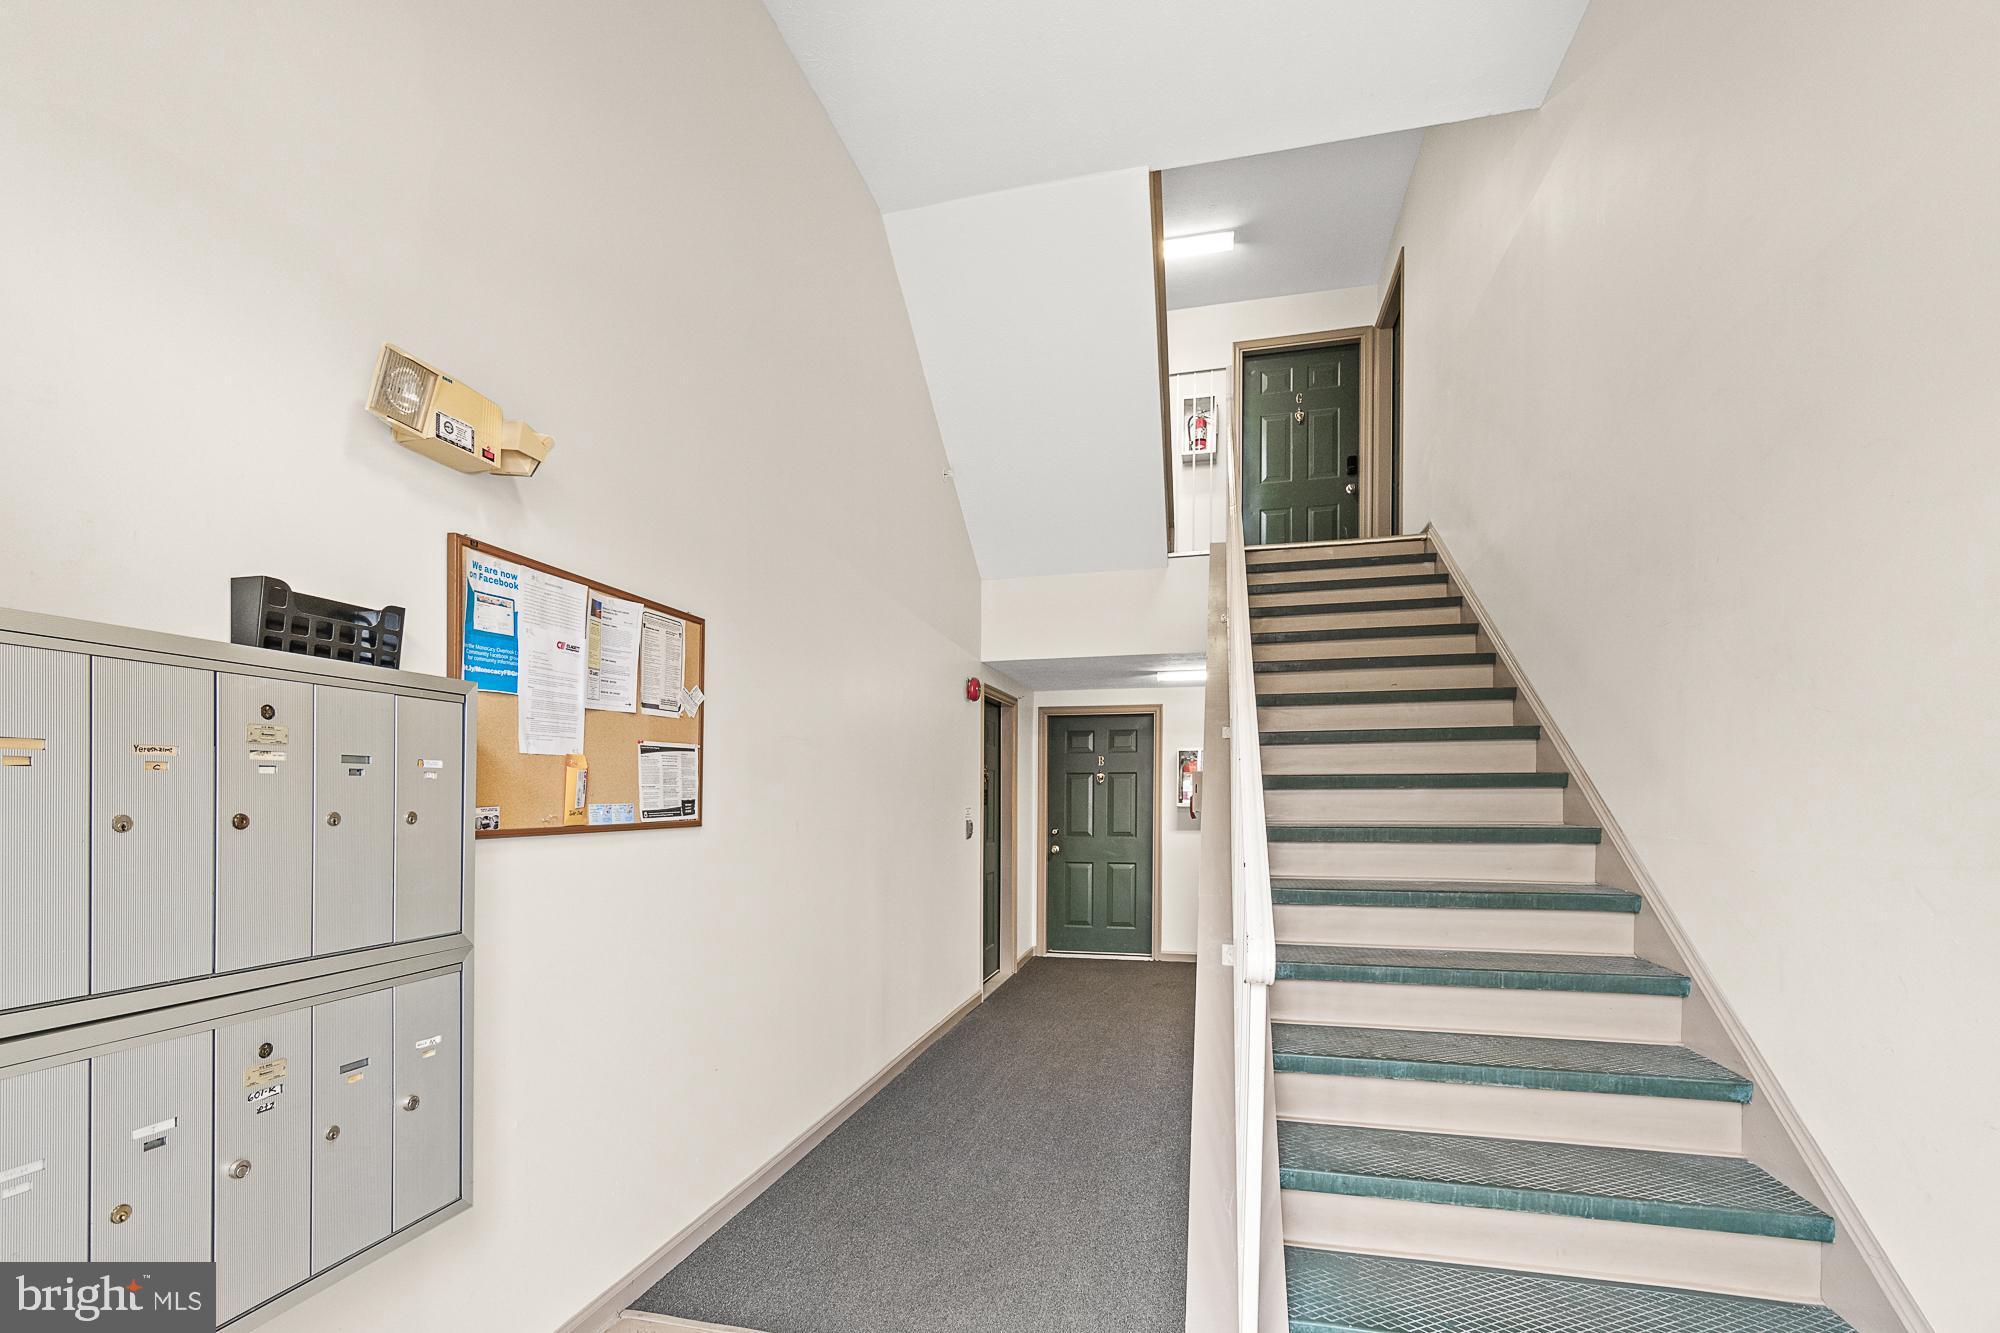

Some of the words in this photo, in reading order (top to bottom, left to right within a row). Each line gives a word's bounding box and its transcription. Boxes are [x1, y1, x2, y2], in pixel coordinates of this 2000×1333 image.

[1295, 392, 1303, 404] G
[472, 560, 483, 571] We
[484, 566, 498, 576] are
[500, 571, 518, 580] now
[469, 571, 478, 579] on
[478, 573, 519, 590] Facebook
[1098, 755, 1105, 766] B
